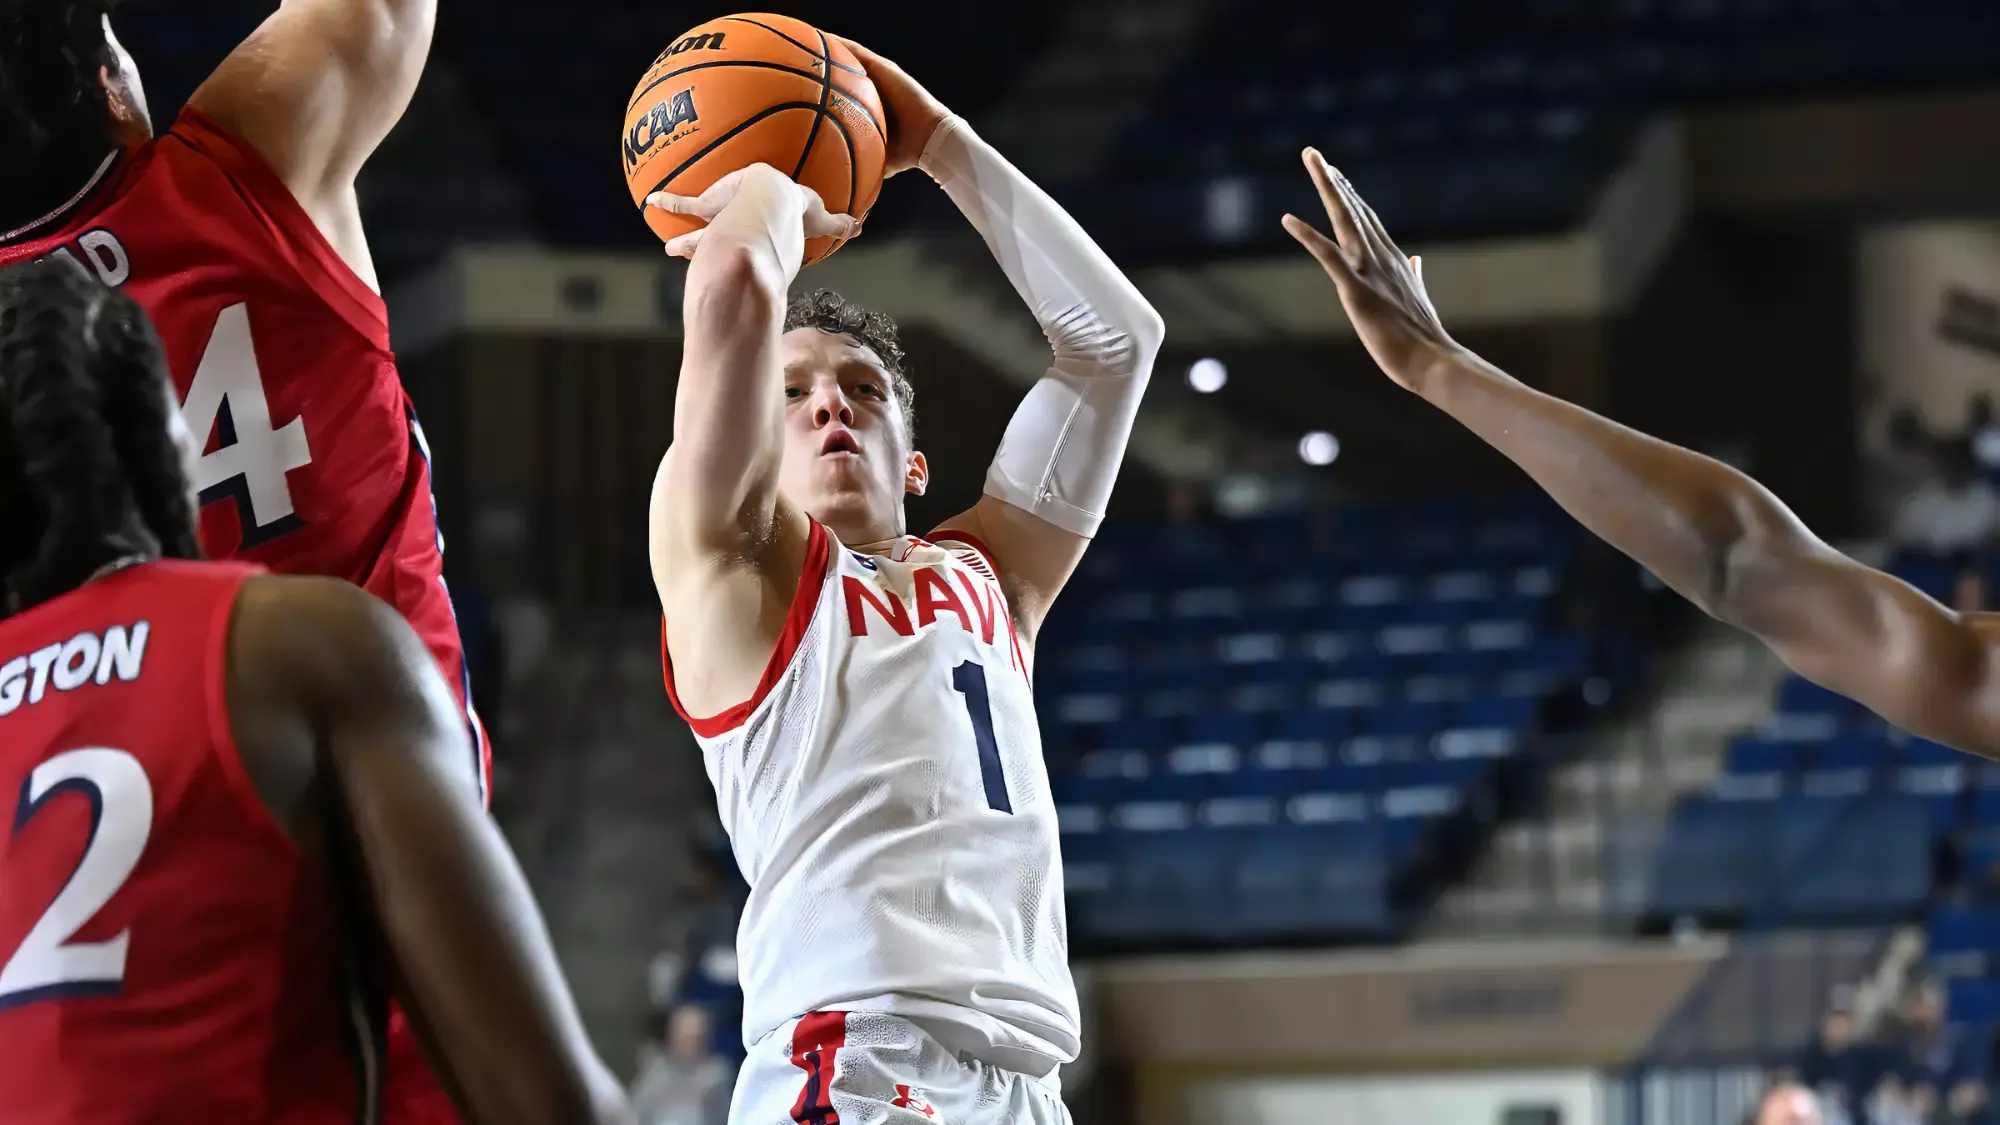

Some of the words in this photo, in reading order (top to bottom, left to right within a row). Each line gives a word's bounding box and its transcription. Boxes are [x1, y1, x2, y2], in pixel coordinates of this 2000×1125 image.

[624, 88, 699, 175] NCAA
[180, 301, 312, 542] 4
[0, 620, 150, 716] GTON
[952, 659, 1014, 815] 1
[0, 747, 153, 1000] 2
